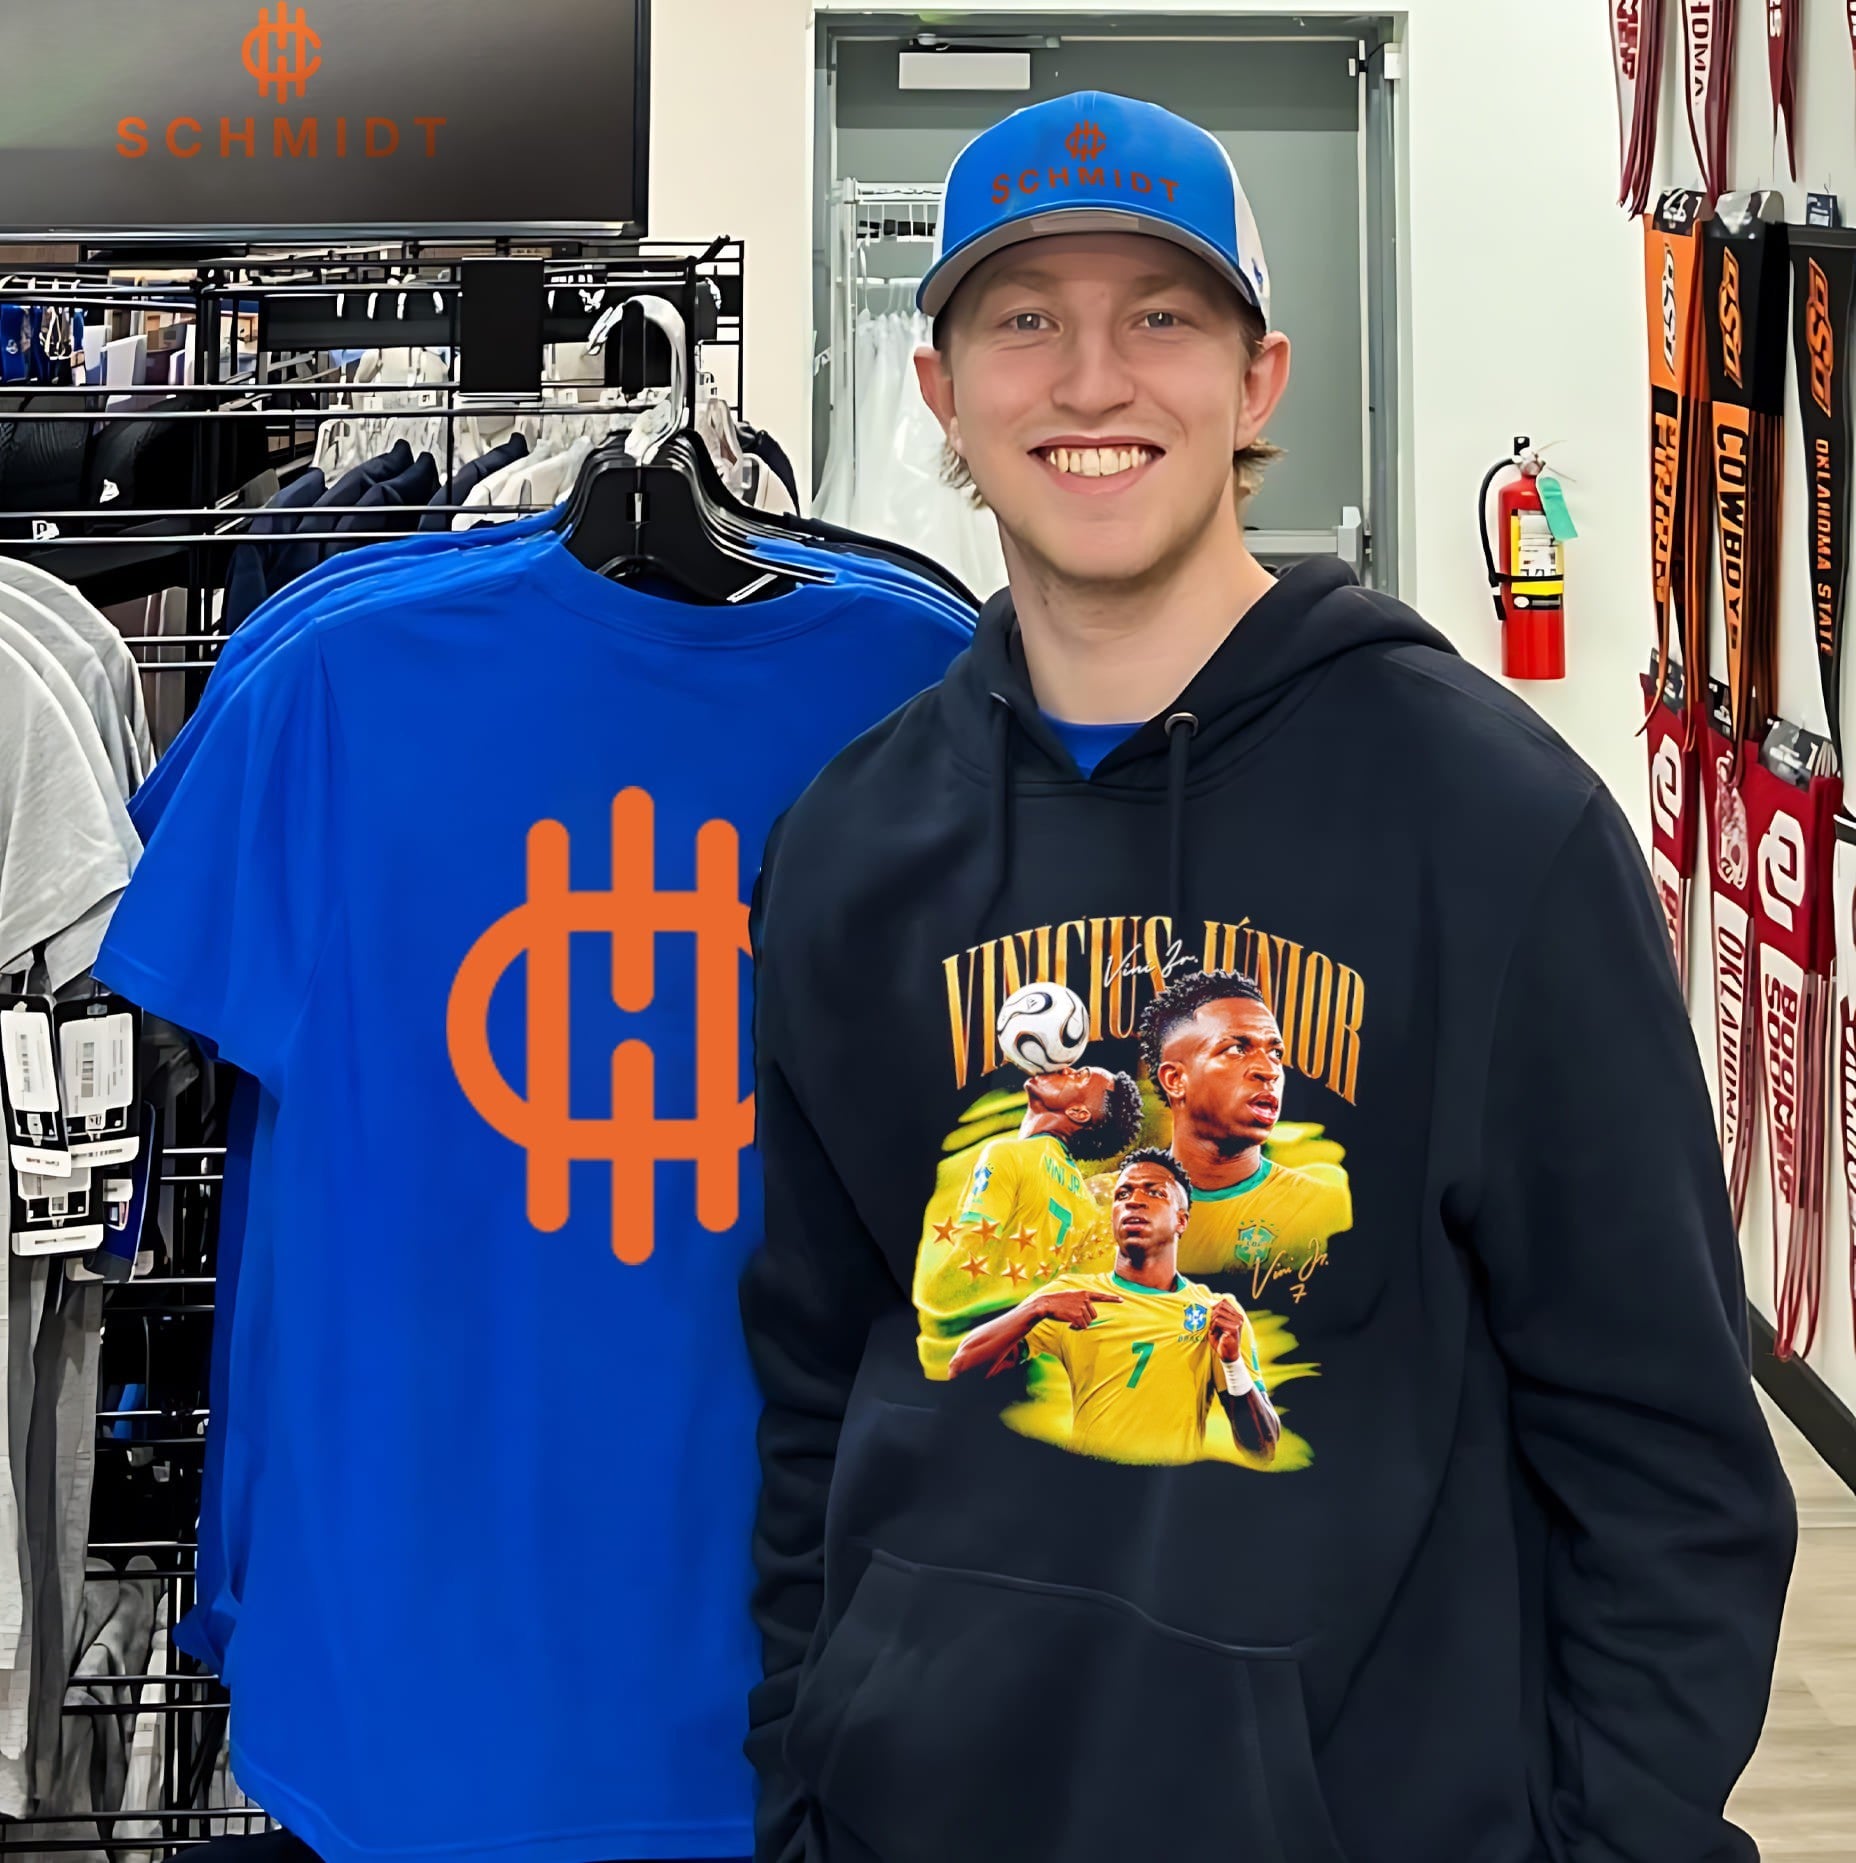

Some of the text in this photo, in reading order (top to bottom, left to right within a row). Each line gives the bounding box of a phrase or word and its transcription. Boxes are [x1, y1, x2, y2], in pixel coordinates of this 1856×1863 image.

[115, 116, 448, 159] SCHMIDT
[991, 166, 1179, 205] SCHMIDT
[1103, 942, 1157, 988] Vini
[1718, 925, 1746, 1144] OKLAHOMA
[1048, 1197, 1073, 1247] 7
[1126, 1342, 1155, 1390] 7
